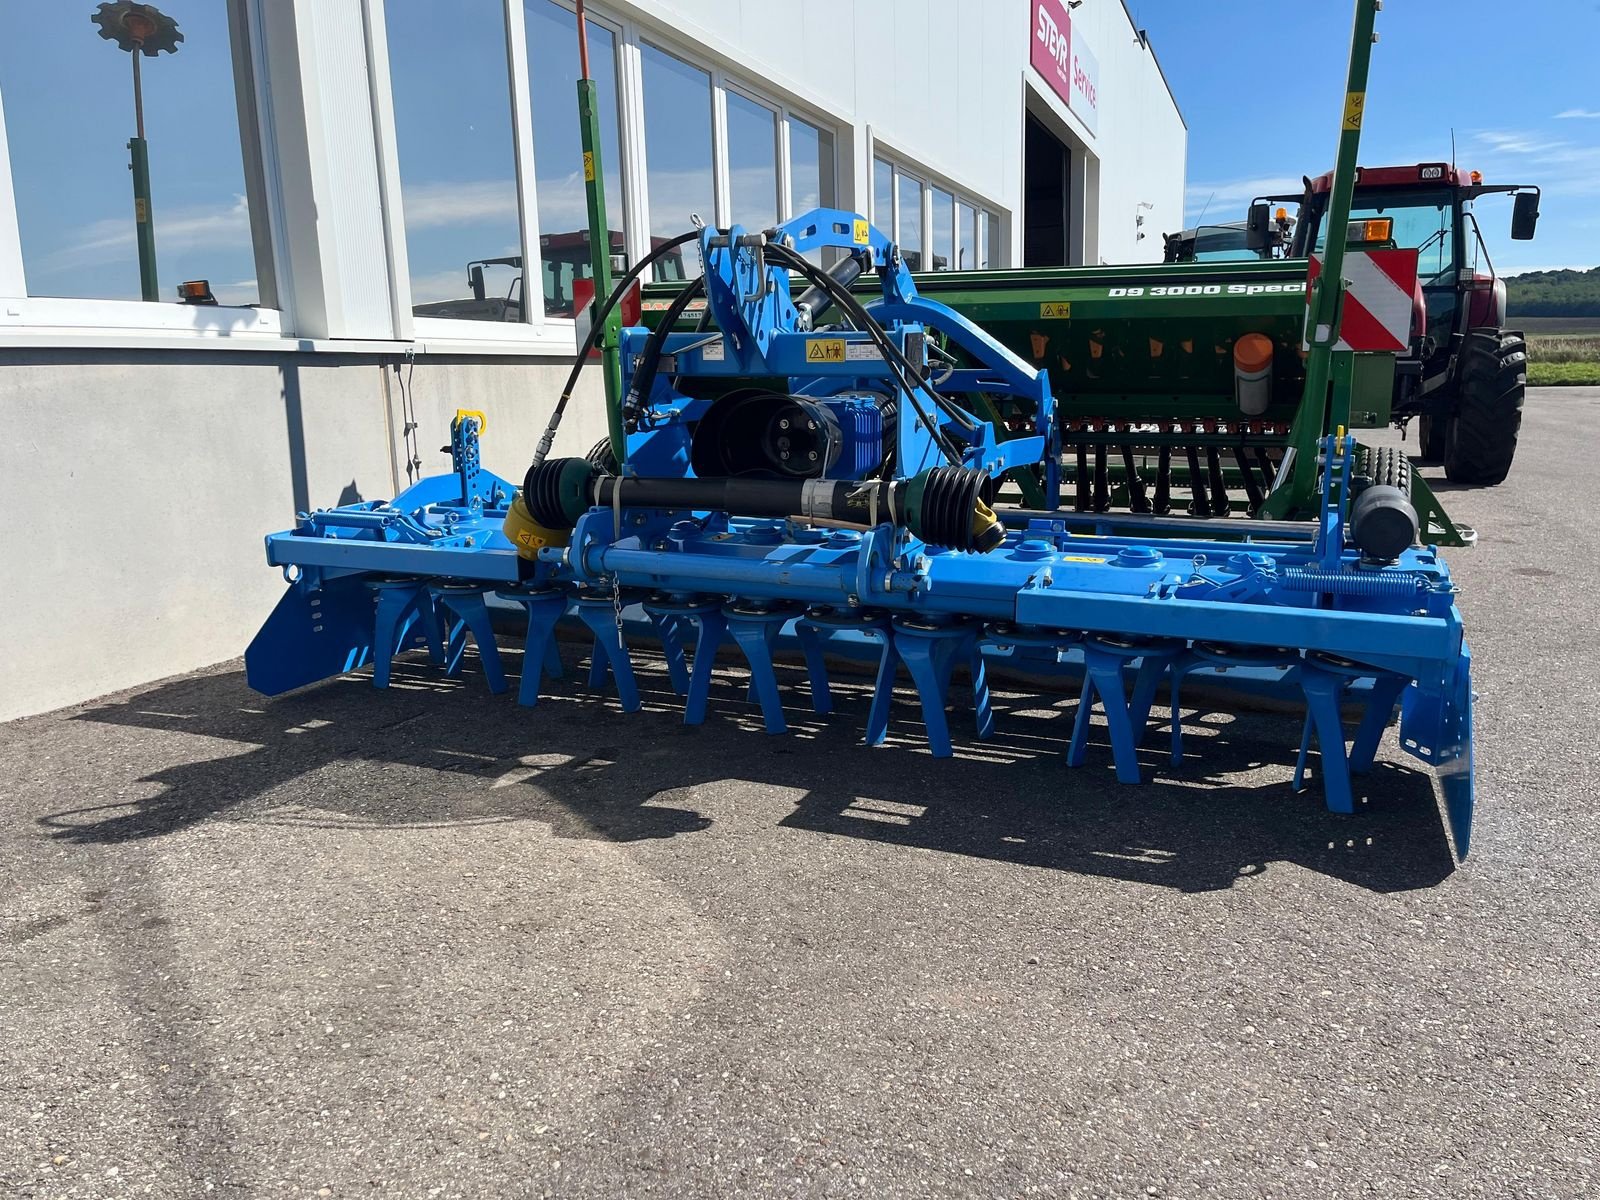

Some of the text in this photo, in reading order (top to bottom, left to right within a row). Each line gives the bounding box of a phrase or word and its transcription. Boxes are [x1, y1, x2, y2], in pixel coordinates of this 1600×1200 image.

[1037, 4, 1067, 72] STEYR
[1074, 55, 1096, 109] Service
[1107, 282, 1307, 297] D9 3000 Speci
